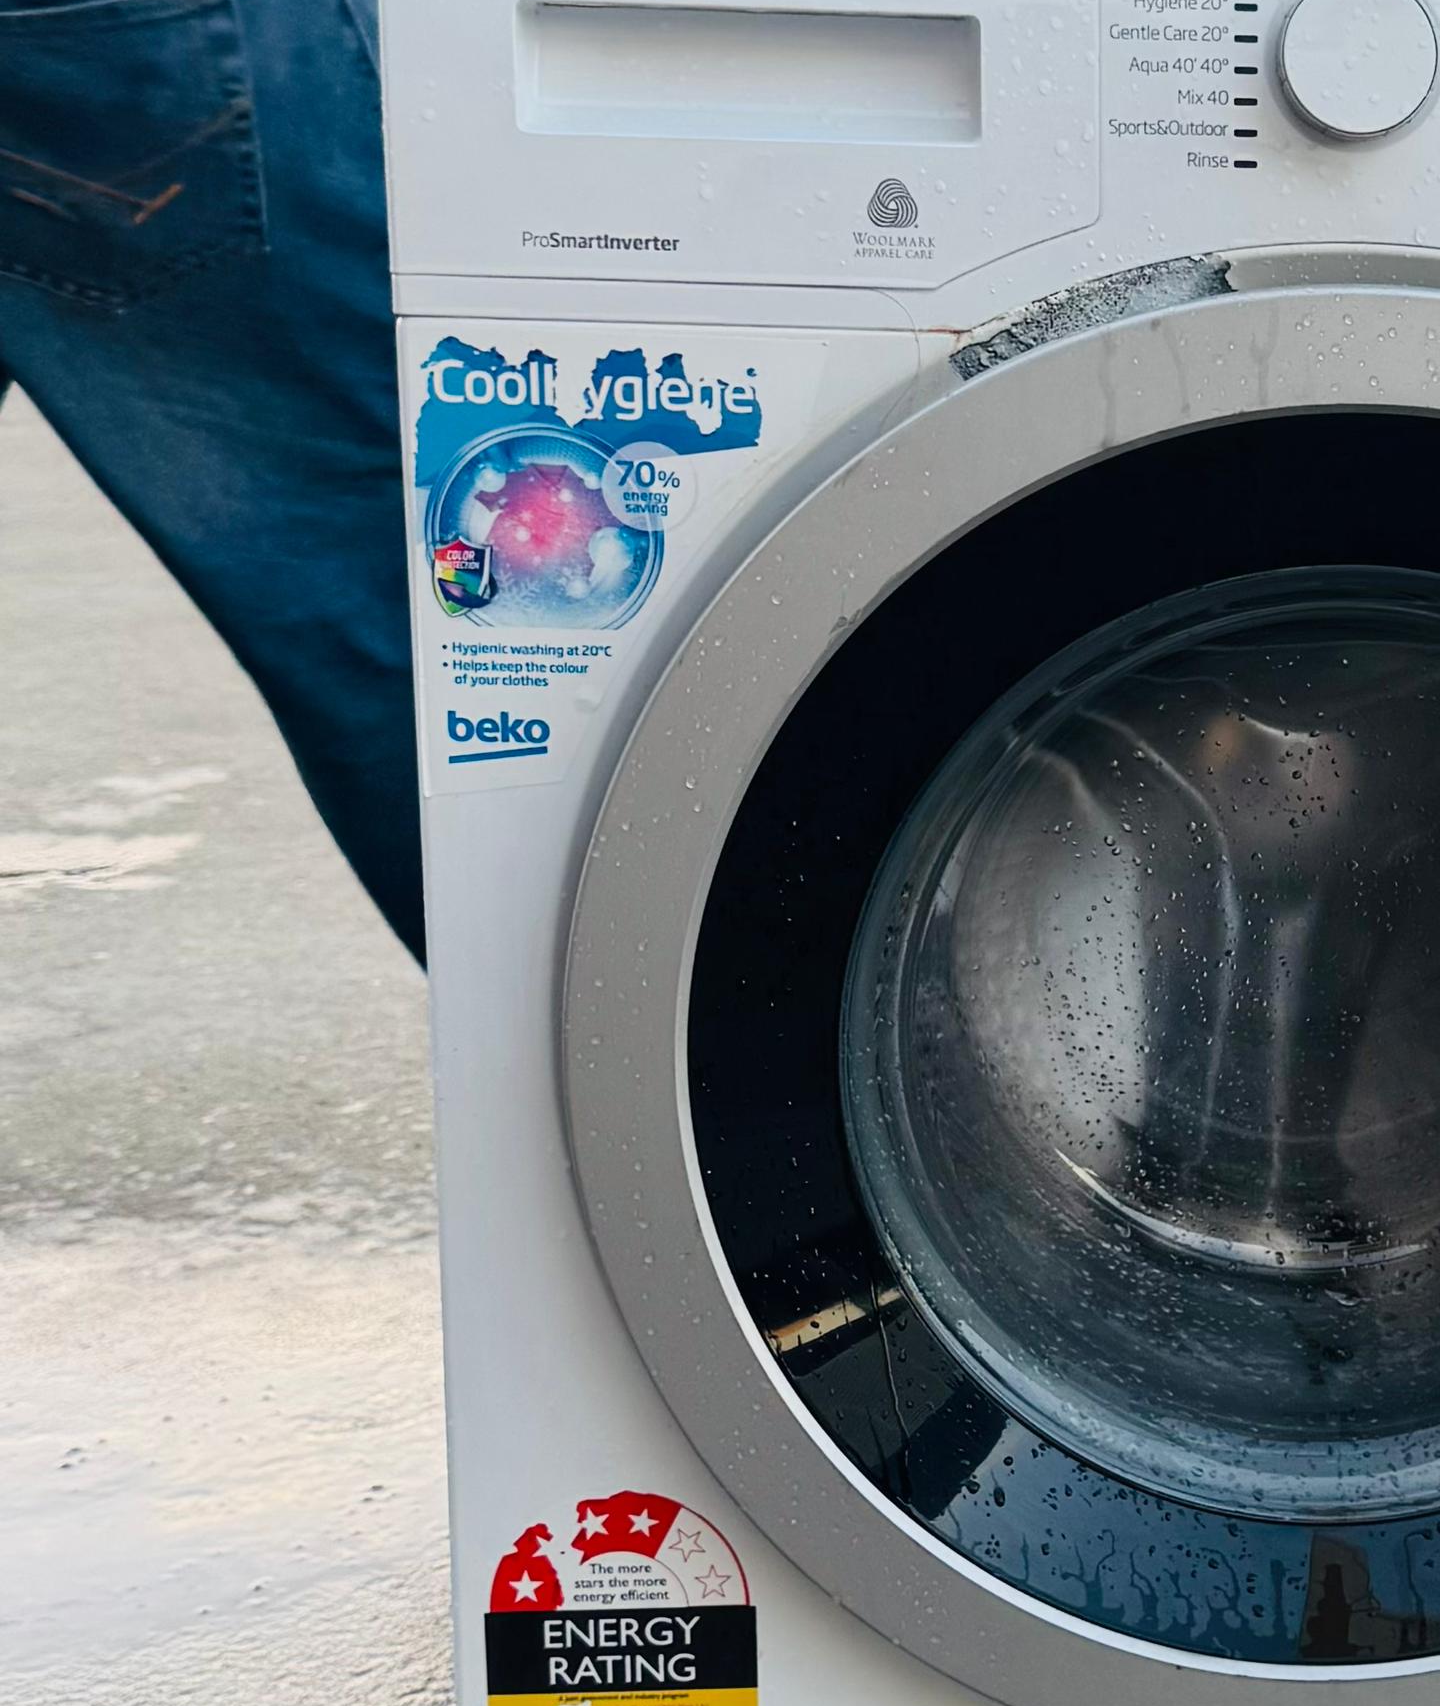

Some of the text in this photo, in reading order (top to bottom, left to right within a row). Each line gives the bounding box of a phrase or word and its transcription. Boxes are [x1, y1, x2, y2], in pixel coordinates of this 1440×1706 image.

[1109, 23, 1160, 42] Gentle
[1162, 24, 1198, 42] Care
[1129, 57, 1168, 76] Aqua
[1177, 89, 1229, 106] Mix 40
[1108, 118, 1228, 138] Sports&Outdoor
[1186, 151, 1229, 169] Rinse
[521, 230, 680, 253] ProSmartInverter
[852, 231, 936, 248] WOOLMARK
[854, 247, 934, 260] APPAREL CARE
[615, 460, 681, 489] 70%
[623, 491, 670, 504] energy
[625, 503, 668, 517] saving
[452, 642, 508, 656] Hygienic
[510, 643, 563, 658] washing
[566, 645, 579, 657] at
[452, 659, 589, 674] Helps keep the colour
[454, 673, 549, 687] of your clothes
[448, 710, 550, 744] beko
[590, 1563, 652, 1574] The more
[574, 1576, 667, 1589] stars the more
[573, 1589, 670, 1604] energy efficient
[543, 1616, 700, 1650] ENERGY
[548, 1654, 697, 1686] RATING
